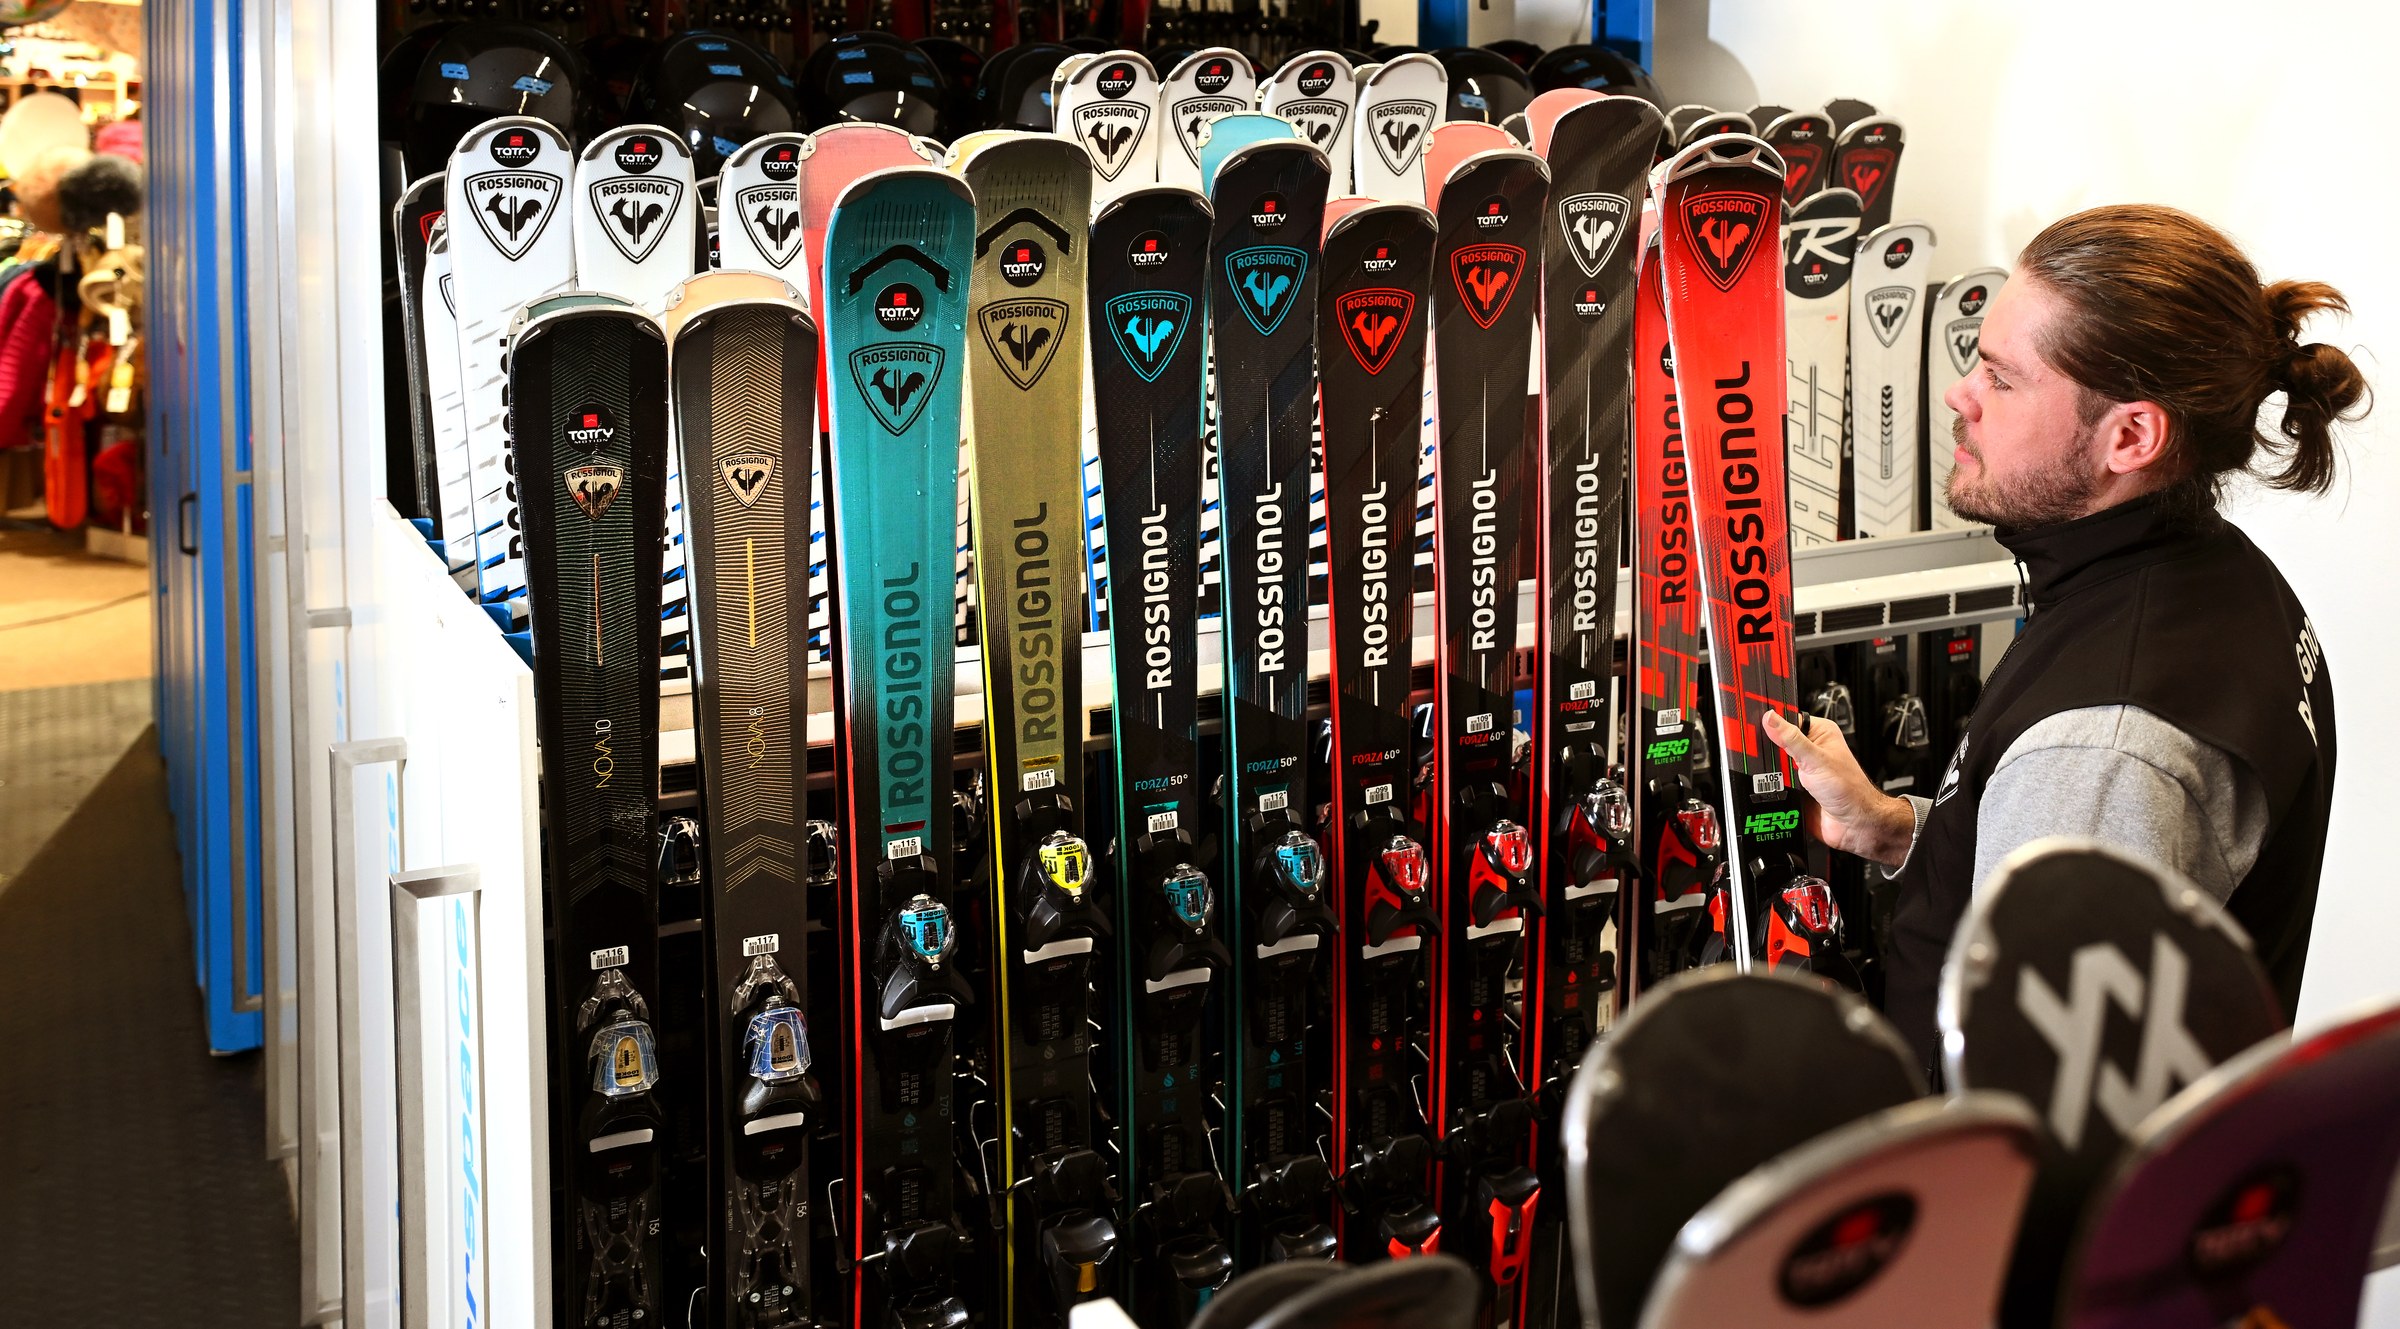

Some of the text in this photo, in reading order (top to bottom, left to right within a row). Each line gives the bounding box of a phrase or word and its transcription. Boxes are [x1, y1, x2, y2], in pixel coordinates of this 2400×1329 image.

[1100, 80, 1133, 89] TATRY
[1083, 107, 1139, 120] ROSSIGNOL
[1286, 105, 1338, 117] ROSSIGNOL
[1377, 106, 1427, 119] ROSSIGNOL
[494, 145, 536, 157] TATRY
[618, 153, 660, 164] TATRY
[478, 177, 550, 193] ROSSIGNOL
[602, 182, 671, 198] ROSSIGNOL
[748, 191, 798, 204] ROSSIGN
[1569, 202, 1621, 215] ROSSIGNOL
[1692, 200, 1758, 216] ROSSIGNOL
[1252, 213, 1287, 225] TATRY
[1477, 214, 1509, 226] TATRY
[1132, 251, 1168, 263] TATRY
[1237, 254, 1297, 269] ROSSIGNOL
[1461, 251, 1516, 265] ROSSIGNOL
[1003, 262, 1043, 274] TATRY
[1363, 258, 1397, 270] TATRY
[1117, 300, 1181, 315] ROSSIGNOL
[1346, 297, 1404, 311] ROSSIGNOL
[1575, 302, 1606, 313] TATRY
[879, 307, 920, 318] TATRY
[990, 305, 1058, 322] ROSSIGNOL
[862, 350, 932, 367] ROSSIGNOL
[568, 427, 614, 440] TATRY
[725, 457, 769, 468] ROSSIGNOL
[571, 469, 618, 480] ROSSIGNOL
[1715, 361, 1775, 645] ROSSIGNOL
[1573, 453, 1599, 631] ROSSIGNOL
[1472, 468, 1497, 652] ROSSIGNOL
[1256, 482, 1285, 673] ROSSIGNOL
[1361, 482, 1389, 668] ROSSIGNOL
[1142, 504, 1172, 689] ROSSIGNOL
[1014, 502, 1057, 744] ROSSIGNOL
[884, 562, 924, 808] ROSSIGNOL
[1580, 682, 1592, 690] 110
[1646, 738, 1690, 760] HERO
[1280, 756, 1298, 768] 50°
[1035, 771, 1050, 779] 114
[1170, 774, 1189, 786] 50°
[1764, 774, 1779, 782] 105
[1159, 813, 1173, 821] 111
[1744, 810, 1800, 835] HERO
[901, 839, 916, 847] 115
[1756, 833, 1774, 842] ELITE
[1776, 832, 1784, 840] ST
[757, 936, 774, 944] 117
[606, 948, 624, 957] 116
[797, 1201, 807, 1218] 156
[649, 1218, 660, 1235] 156
